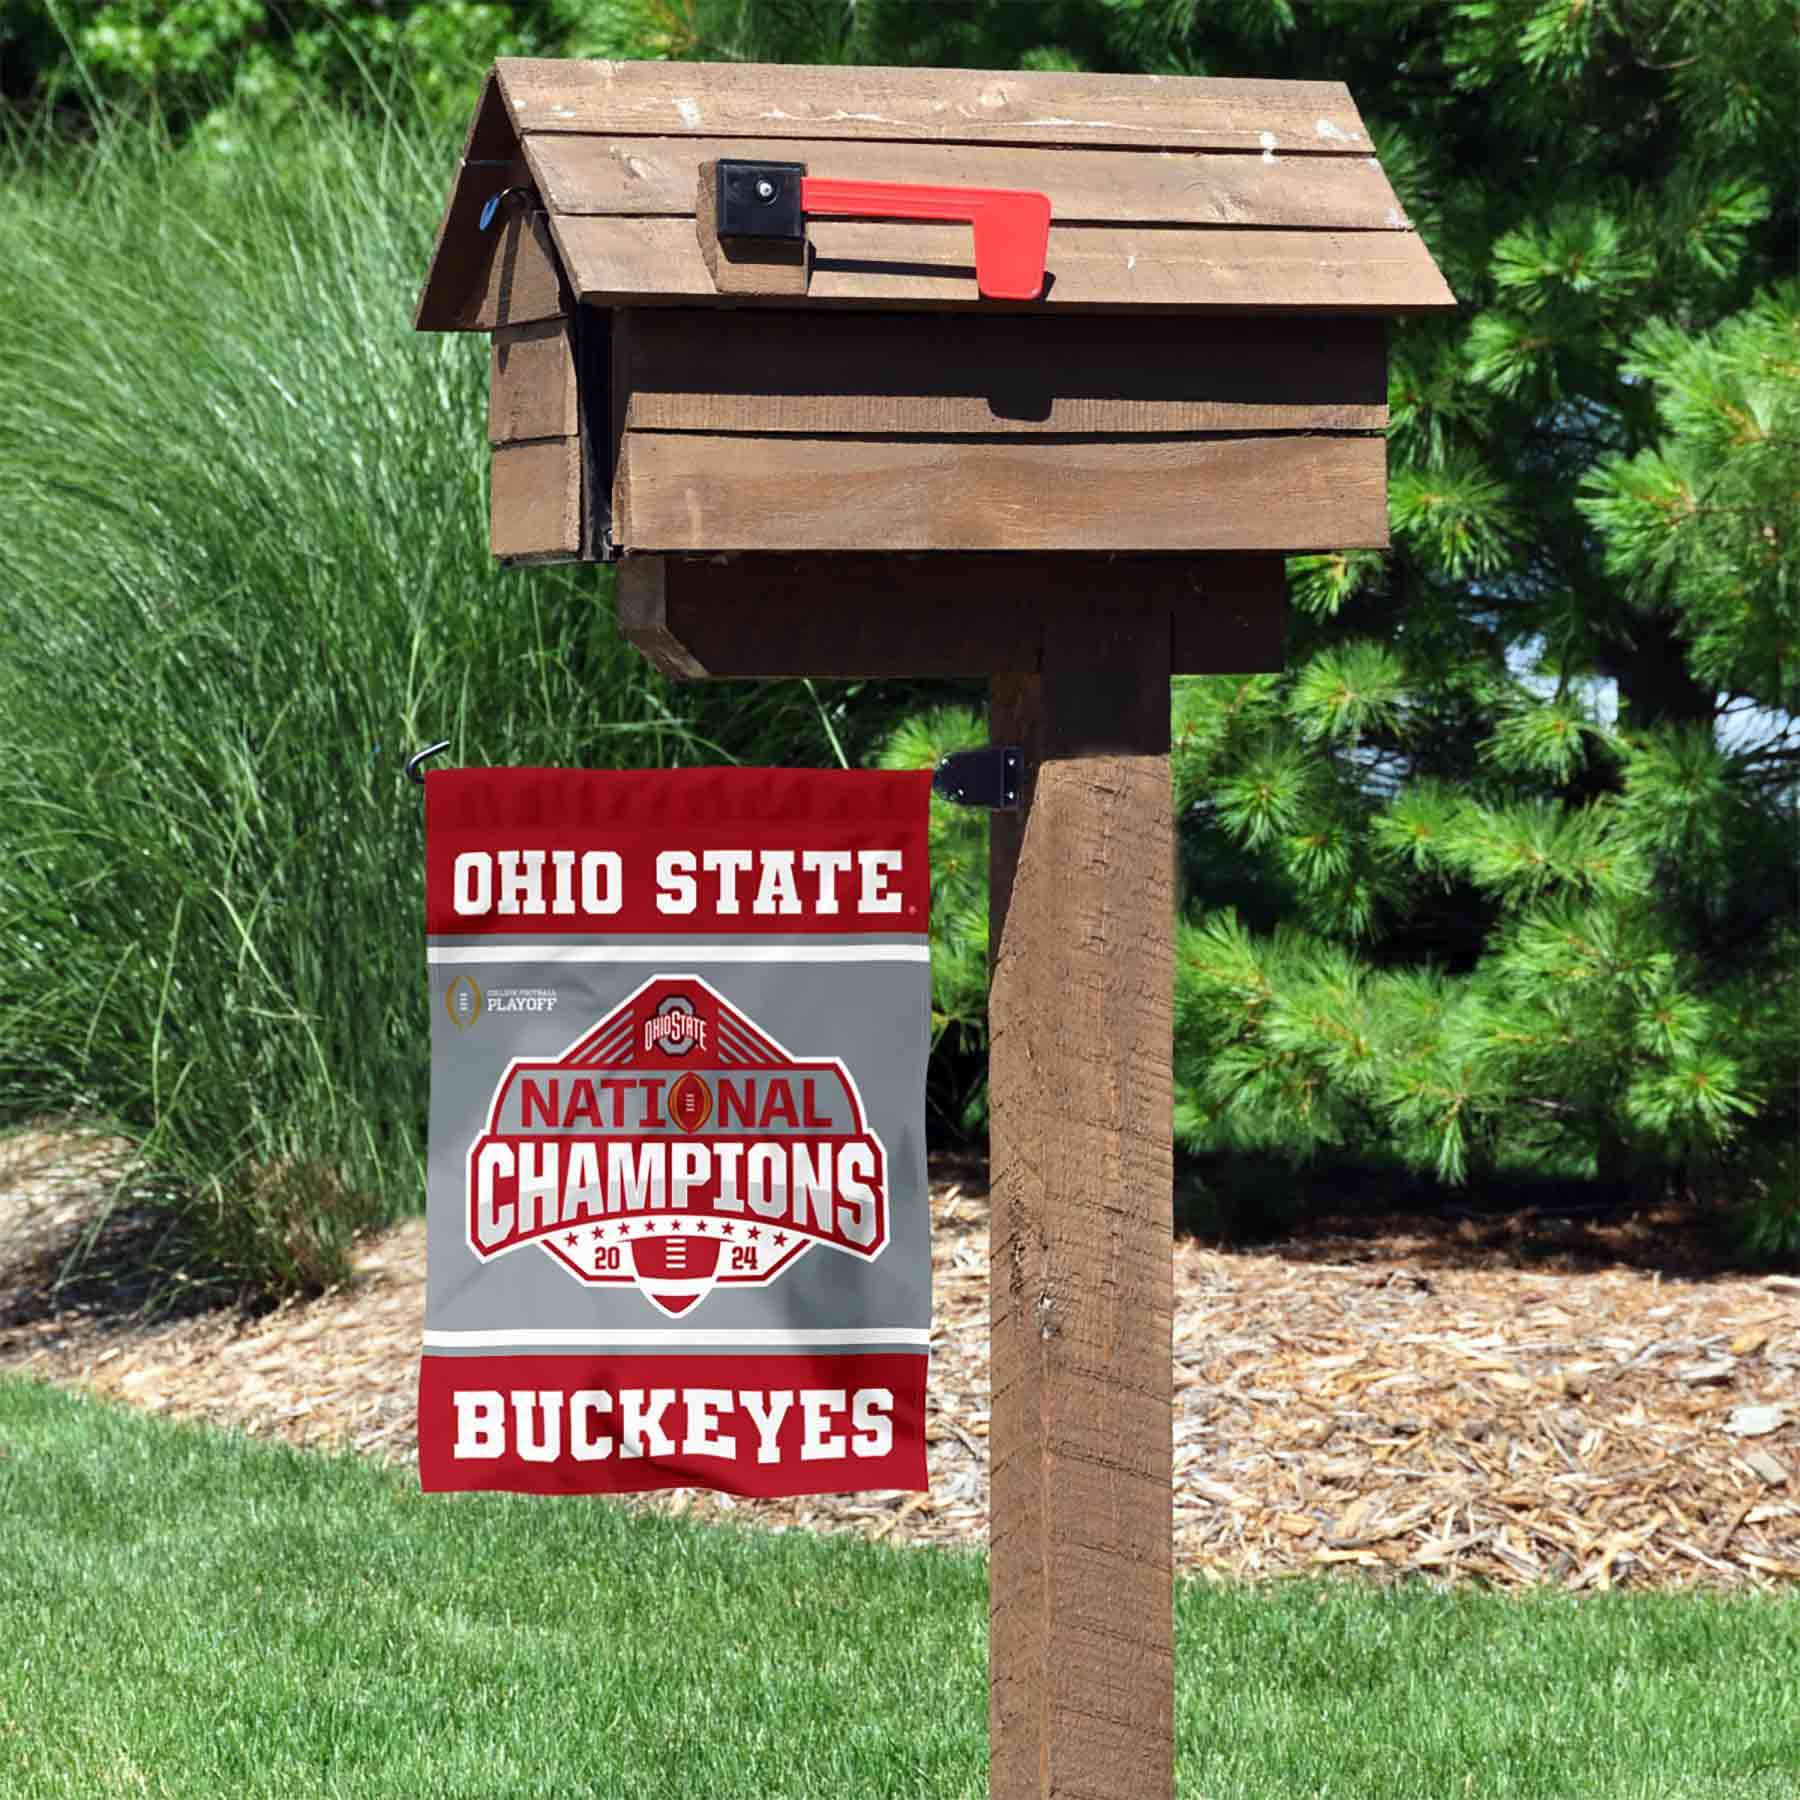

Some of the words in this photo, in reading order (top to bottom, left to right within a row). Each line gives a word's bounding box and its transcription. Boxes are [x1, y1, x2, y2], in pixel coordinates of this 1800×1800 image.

[454, 850, 623, 916] OHIO
[655, 850, 902, 915] STATE
[487, 997, 558, 1011] PLAYOFF
[477, 1141, 884, 1249] CHAMPIONS
[594, 1246, 621, 1270] 20
[731, 1246, 758, 1270] 24
[453, 1387, 895, 1464] BUCKEYES
